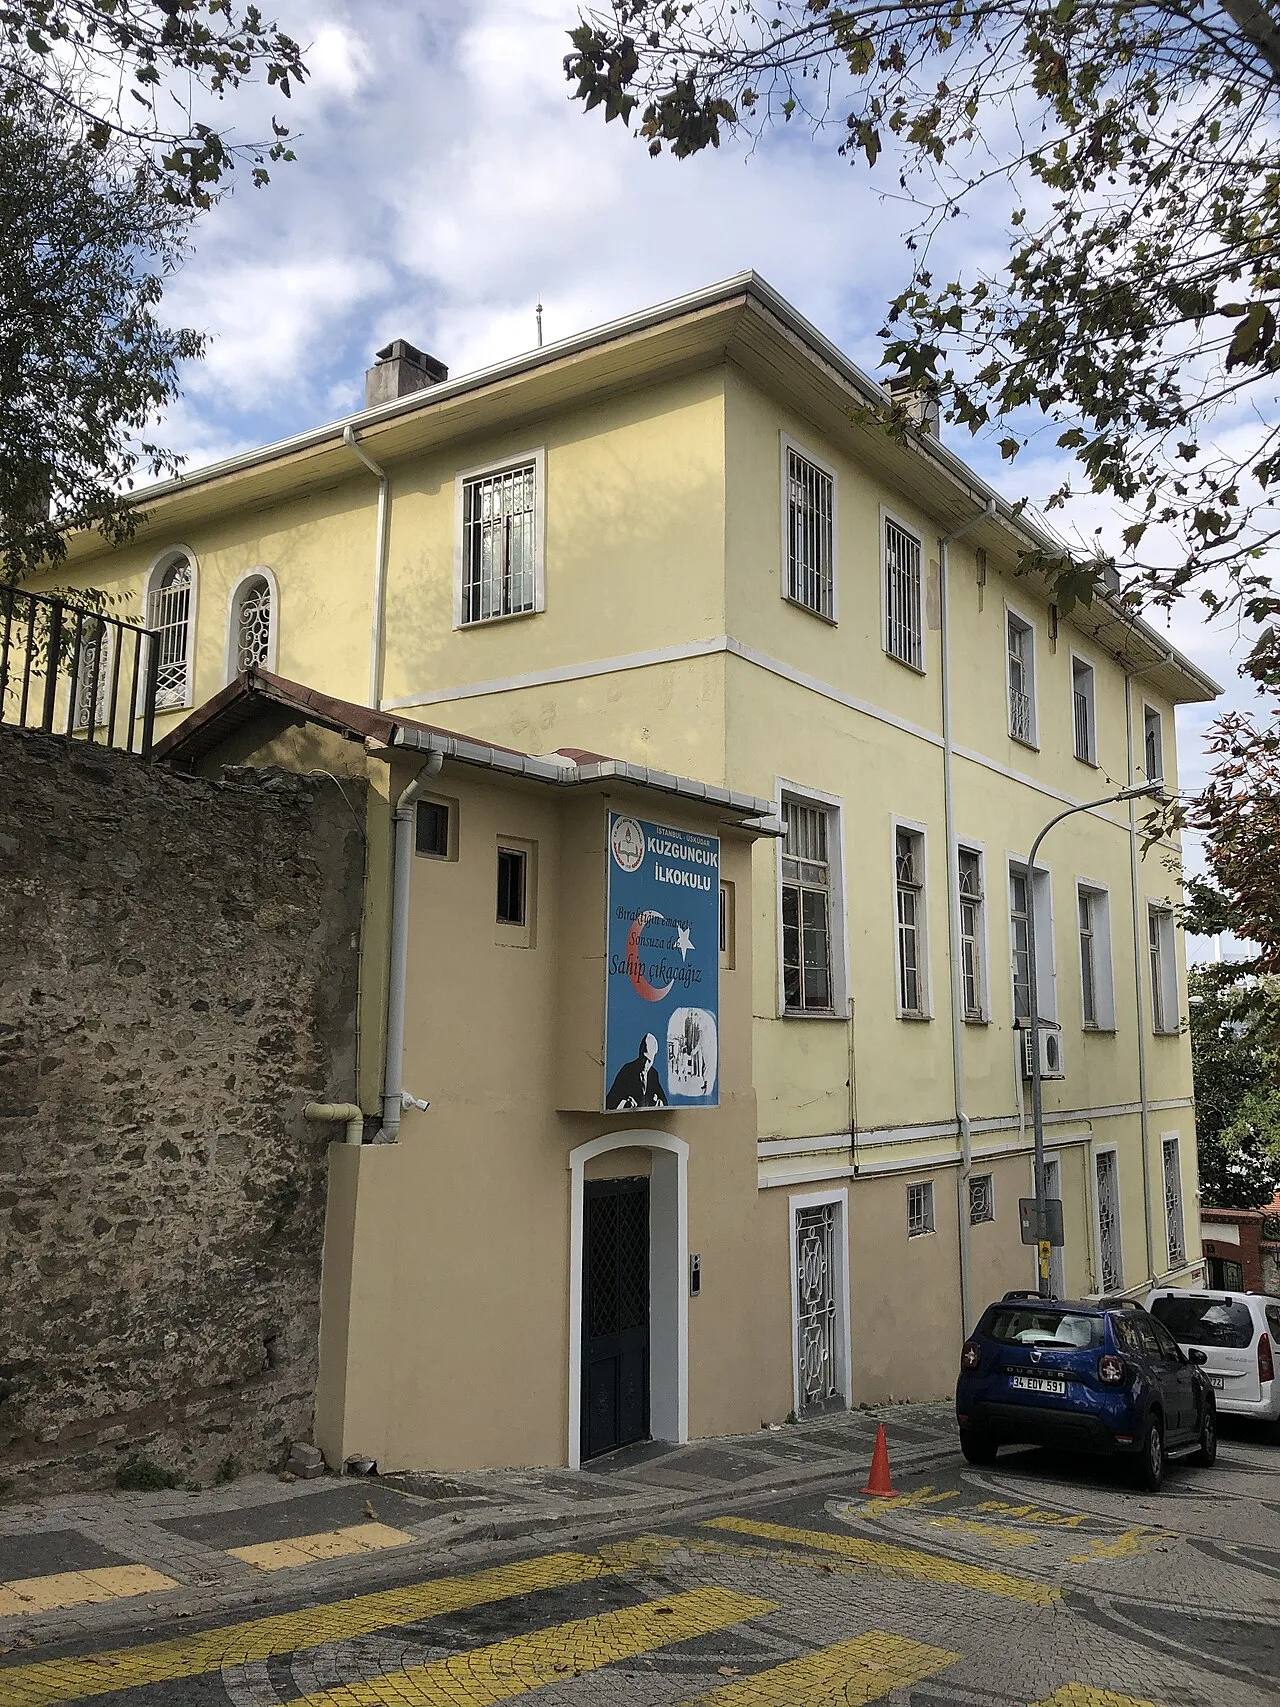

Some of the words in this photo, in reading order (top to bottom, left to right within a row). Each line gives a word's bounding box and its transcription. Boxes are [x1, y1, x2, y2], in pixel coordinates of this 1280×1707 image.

[656, 826, 683, 840] İSTANBUL
[647, 836, 718, 868] KUZGUNCUK
[655, 861, 711, 891] İLKOKULU
[629, 931, 665, 949] Sonsuza
[608, 953, 646, 984] Sahip
[649, 957, 702, 989] çıkacağız
[1006, 1366, 1065, 1378] DUSTER
[1013, 1377, 1024, 1388] 34
[1046, 1380, 1063, 1392] 591
